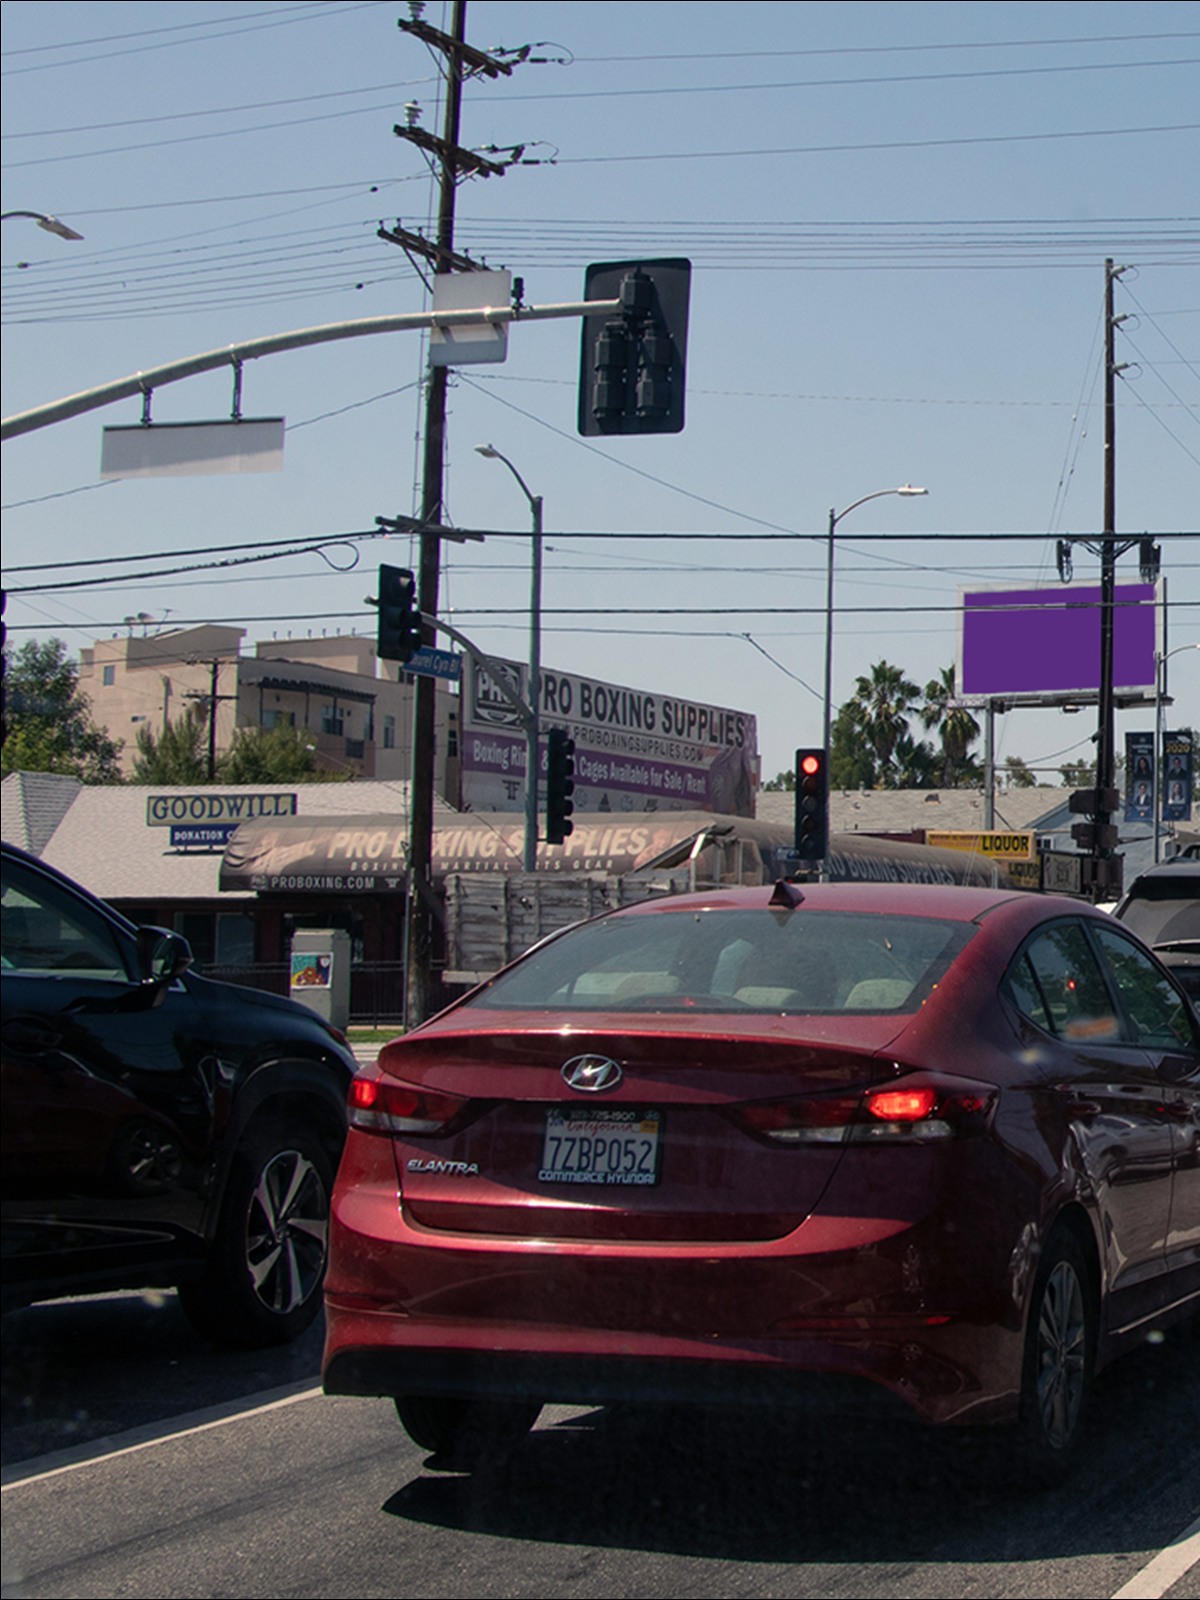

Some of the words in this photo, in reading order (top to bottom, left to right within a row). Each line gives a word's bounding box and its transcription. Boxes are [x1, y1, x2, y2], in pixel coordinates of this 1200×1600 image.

[409, 652, 434, 668] aurel
[433, 653, 450, 674] Cyn
[537, 671, 572, 715] RO
[579, 682, 656, 732] BOXING
[661, 699, 746, 749] SUPPLIES
[473, 740, 509, 770] Boxing
[511, 745, 530, 767] Rin
[579, 756, 608, 783] Cages
[609, 762, 649, 786] Available
[650, 767, 663, 787] for
[152, 796, 288, 820] GOODWILL
[174, 830, 224, 841] DONATION
[327, 831, 388, 859] PRO
[391, 829, 500, 858] BXING
[981, 836, 1029, 851] LIQUOR
[441, 861, 510, 871] MARTIAL
[521, 860, 561, 871] RTS
[573, 860, 613, 870] GEAR
[845, 852, 897, 883] BOXING
[895, 858, 956, 885] SUPPLIES
[1008, 862, 1040, 879] LIQUOR
[272, 876, 375, 889] PROBOXING.COM
[567, 1120, 637, 1137] California
[548, 1136, 654, 1174] 7ZBP052
[407, 1159, 479, 1174] ELANTRA
[538, 1170, 605, 1183] COMMERCE
[606, 1173, 656, 1184] HYUNDAI
